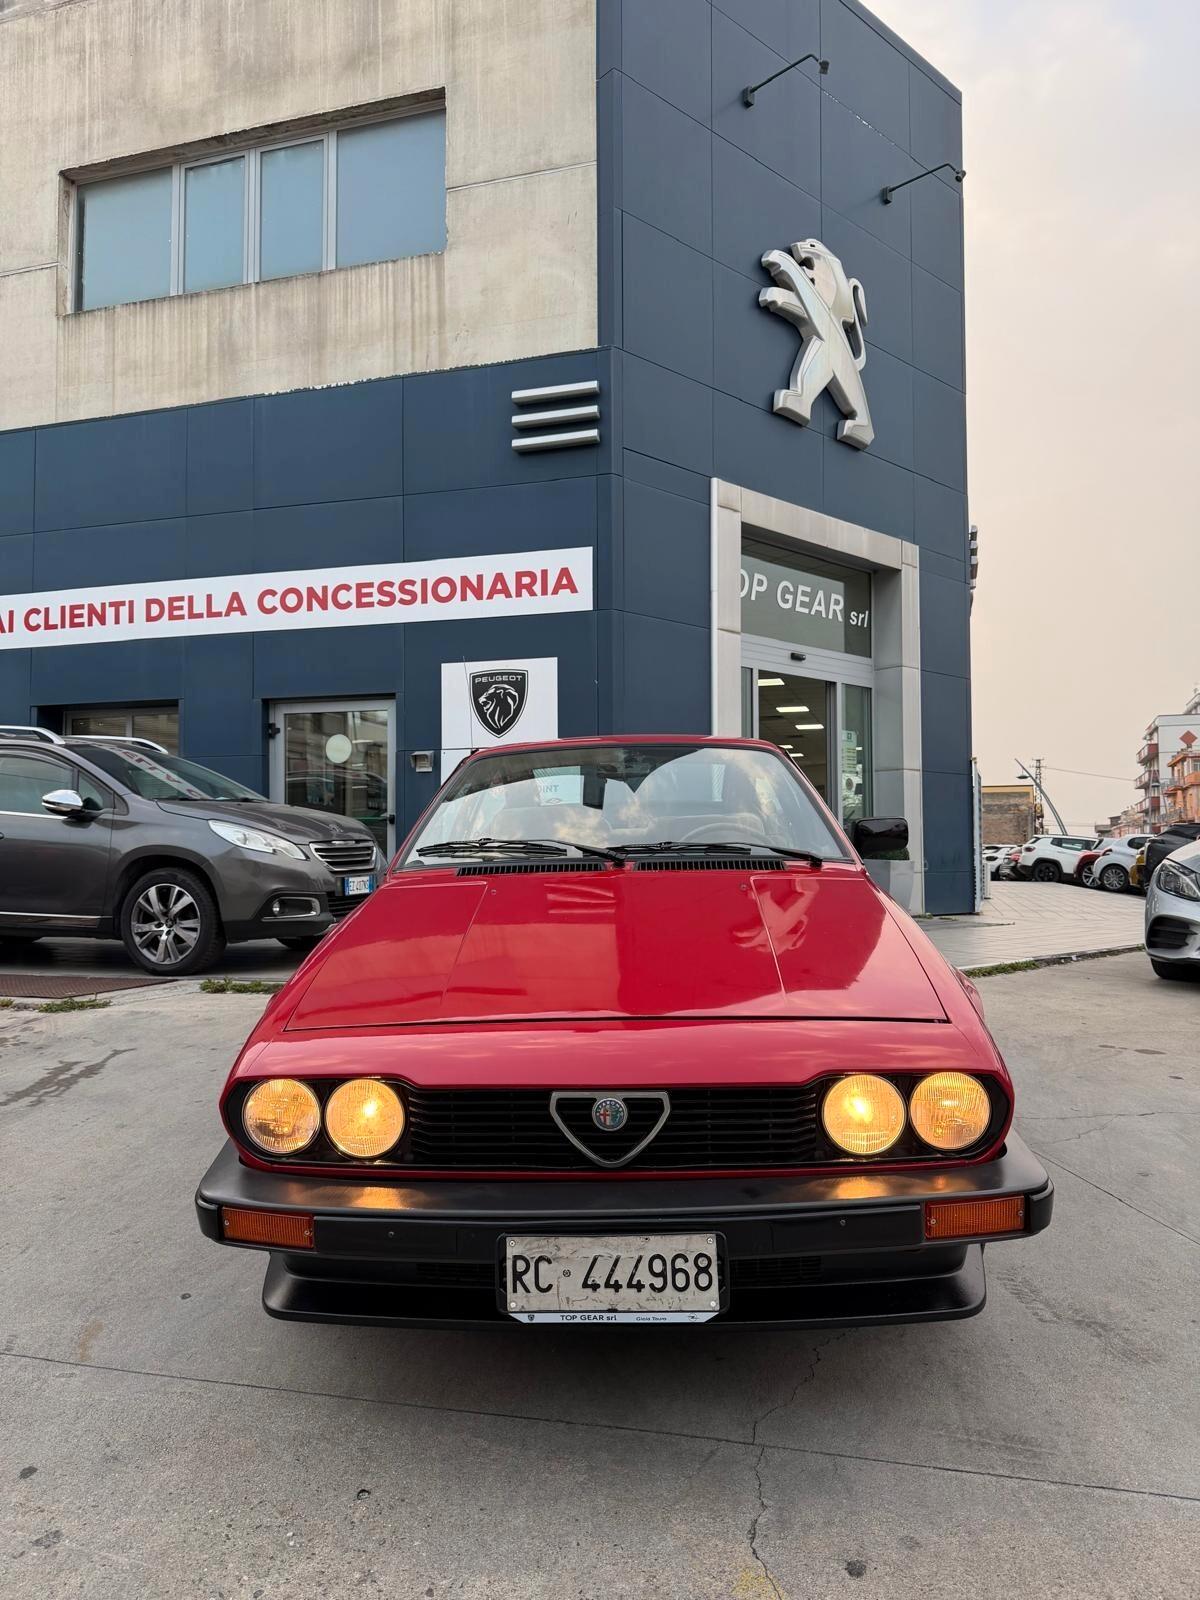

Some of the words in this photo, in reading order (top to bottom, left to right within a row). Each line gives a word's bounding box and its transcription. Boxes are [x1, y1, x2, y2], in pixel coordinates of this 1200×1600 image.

[24, 599, 134, 632] CLIENTI
[145, 592, 247, 622] DELLA
[257, 567, 579, 614] CONCESSIONARIA
[776, 580, 844, 622] GEAR
[850, 610, 869, 628] srl
[475, 675, 522, 683] PEUGEOT
[512, 1254, 553, 1294] RC
[582, 1253, 713, 1292] 444968
